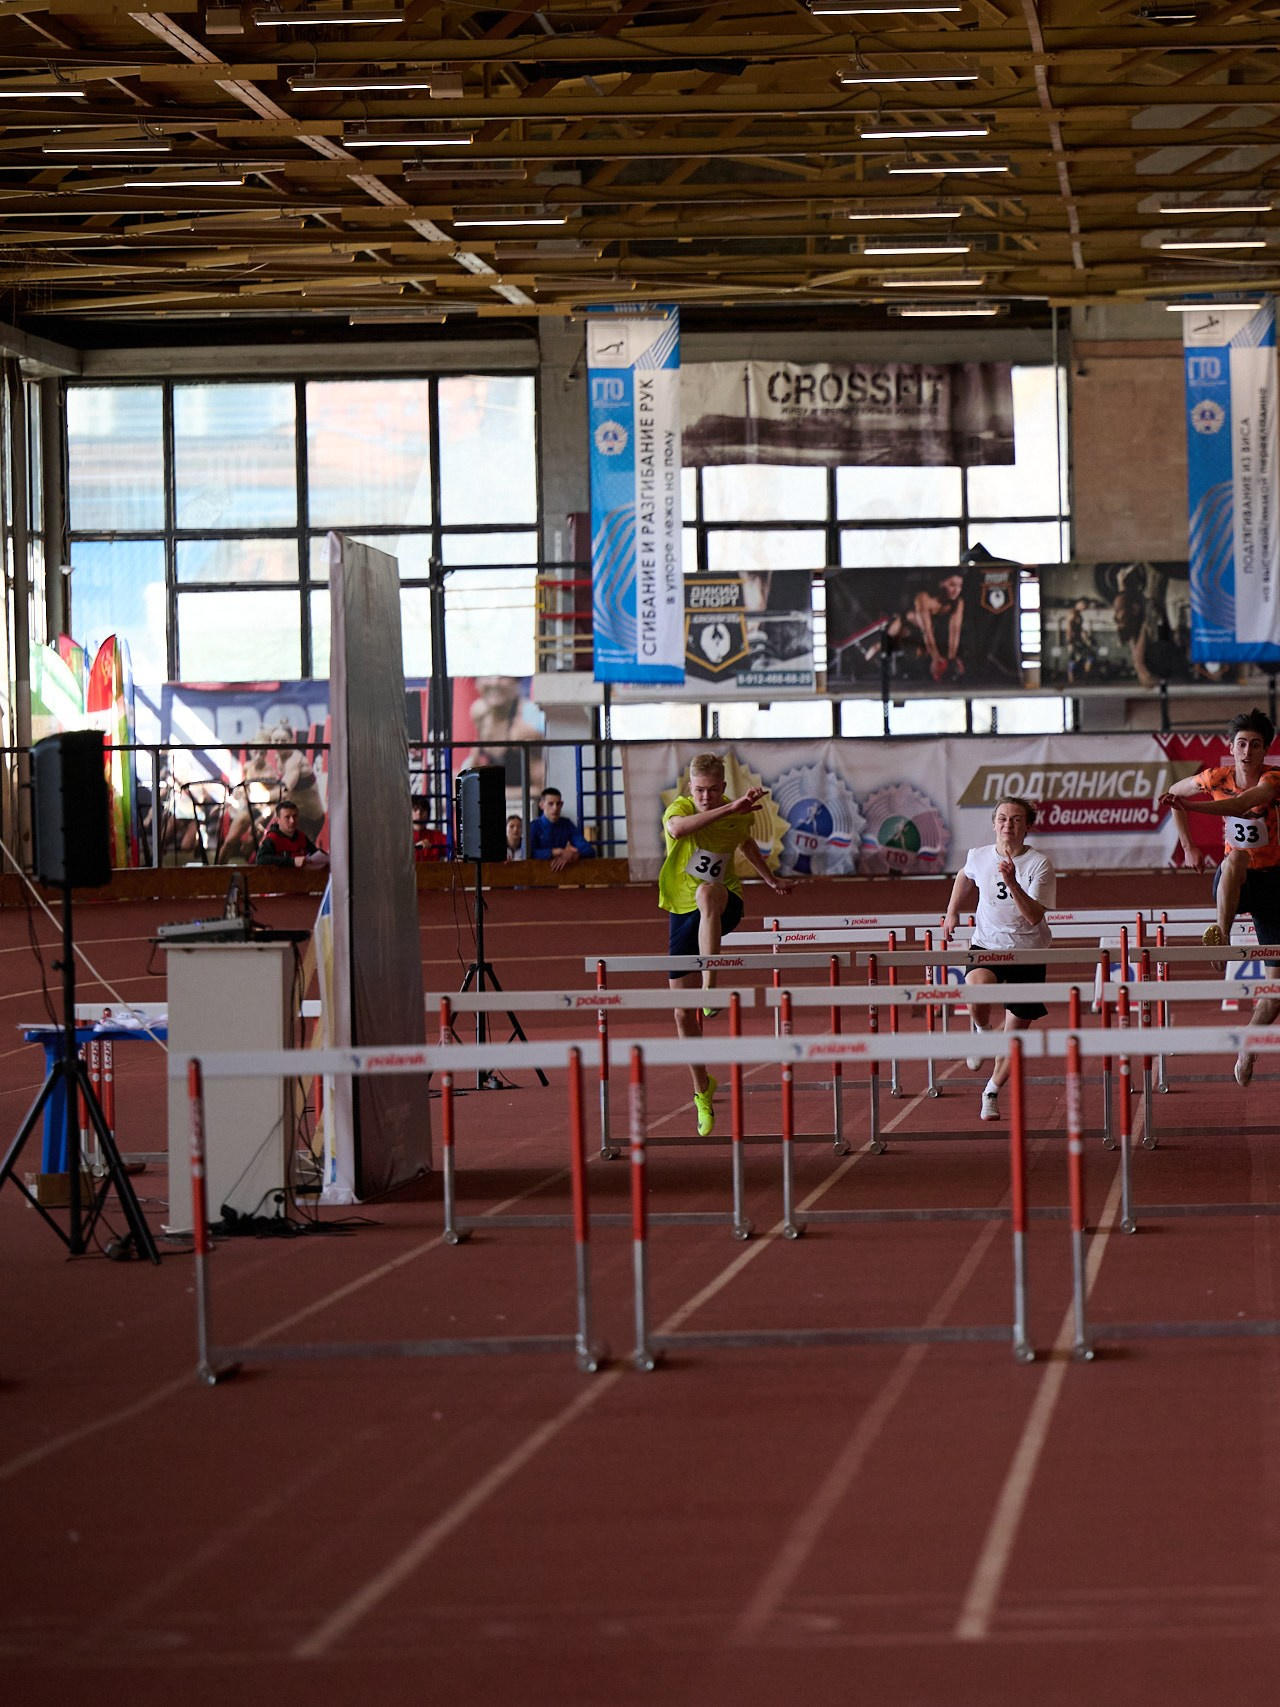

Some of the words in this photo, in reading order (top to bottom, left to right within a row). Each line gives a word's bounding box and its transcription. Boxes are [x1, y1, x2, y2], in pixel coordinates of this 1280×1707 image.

[639, 378, 654, 411] РУК
[768, 371, 944, 405] CROSSFIT
[1239, 417, 1252, 453] ВИСА
[662, 430, 676, 467] полу
[640, 418, 656, 535] РАЗГИБАНИЕ
[663, 471, 675, 491] на
[663, 495, 676, 538] лежа
[640, 541, 656, 553] И
[664, 542, 678, 592] упоре
[690, 584, 740, 598] ДИКИЙ
[641, 560, 658, 656] СГИБАНИЕ
[689, 596, 739, 607] СПОРТ
[795, 834, 818, 849] ГТО
[1234, 823, 1260, 843] 33
[695, 855, 723, 878] 36
[885, 850, 909, 865] ГТО
[996, 881, 1013, 900] 3
[851, 917, 879, 926] polanik
[785, 932, 817, 943] polanik
[706, 957, 744, 969] polanik
[977, 952, 1015, 963] polanik
[575, 993, 623, 1007] polanik
[915, 989, 962, 1002] polanik
